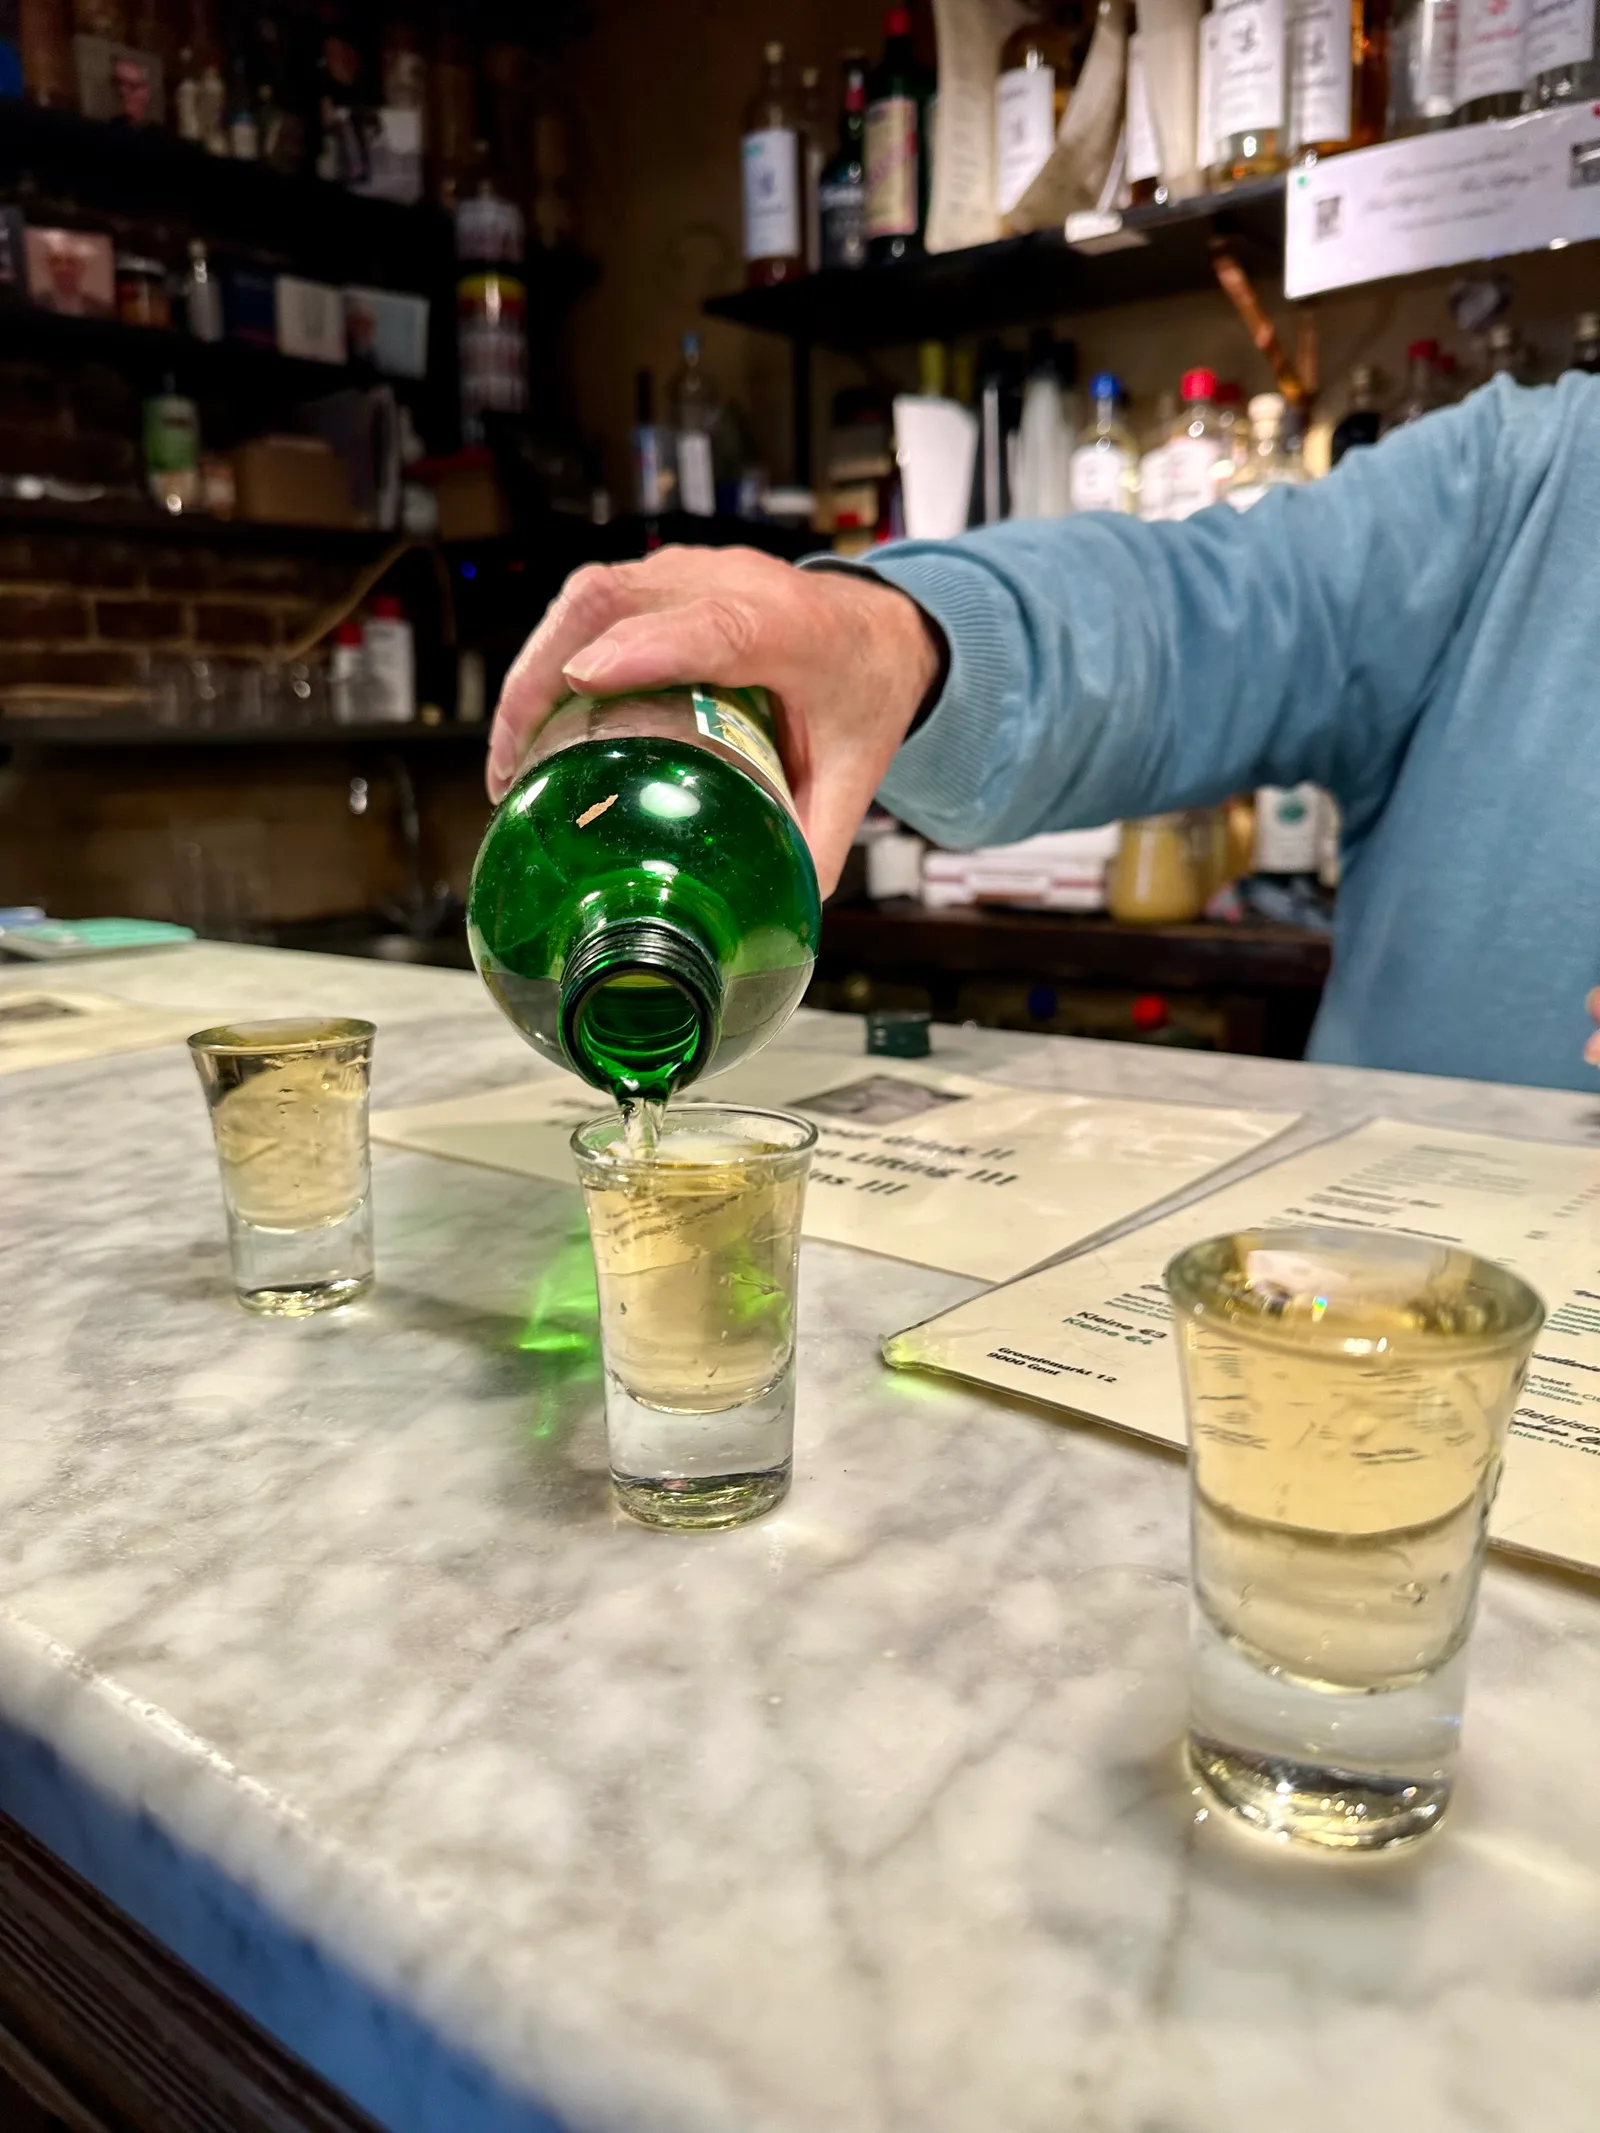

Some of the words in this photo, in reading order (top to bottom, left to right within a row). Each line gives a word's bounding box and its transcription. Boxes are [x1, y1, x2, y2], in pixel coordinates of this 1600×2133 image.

[1062, 1317, 1120, 1337] Kleine
[1077, 1311, 1134, 1331] Kleine
[1138, 1328, 1168, 1339] €3
[986, 1351, 1026, 1366] 9000
[1026, 1363, 1061, 1376] Gent
[997, 1347, 1093, 1376] Groentemarkt
[1096, 1373, 1118, 1384] 12
[1531, 1374, 1572, 1387] Peket
[1524, 1387, 1583, 1405] Williams
